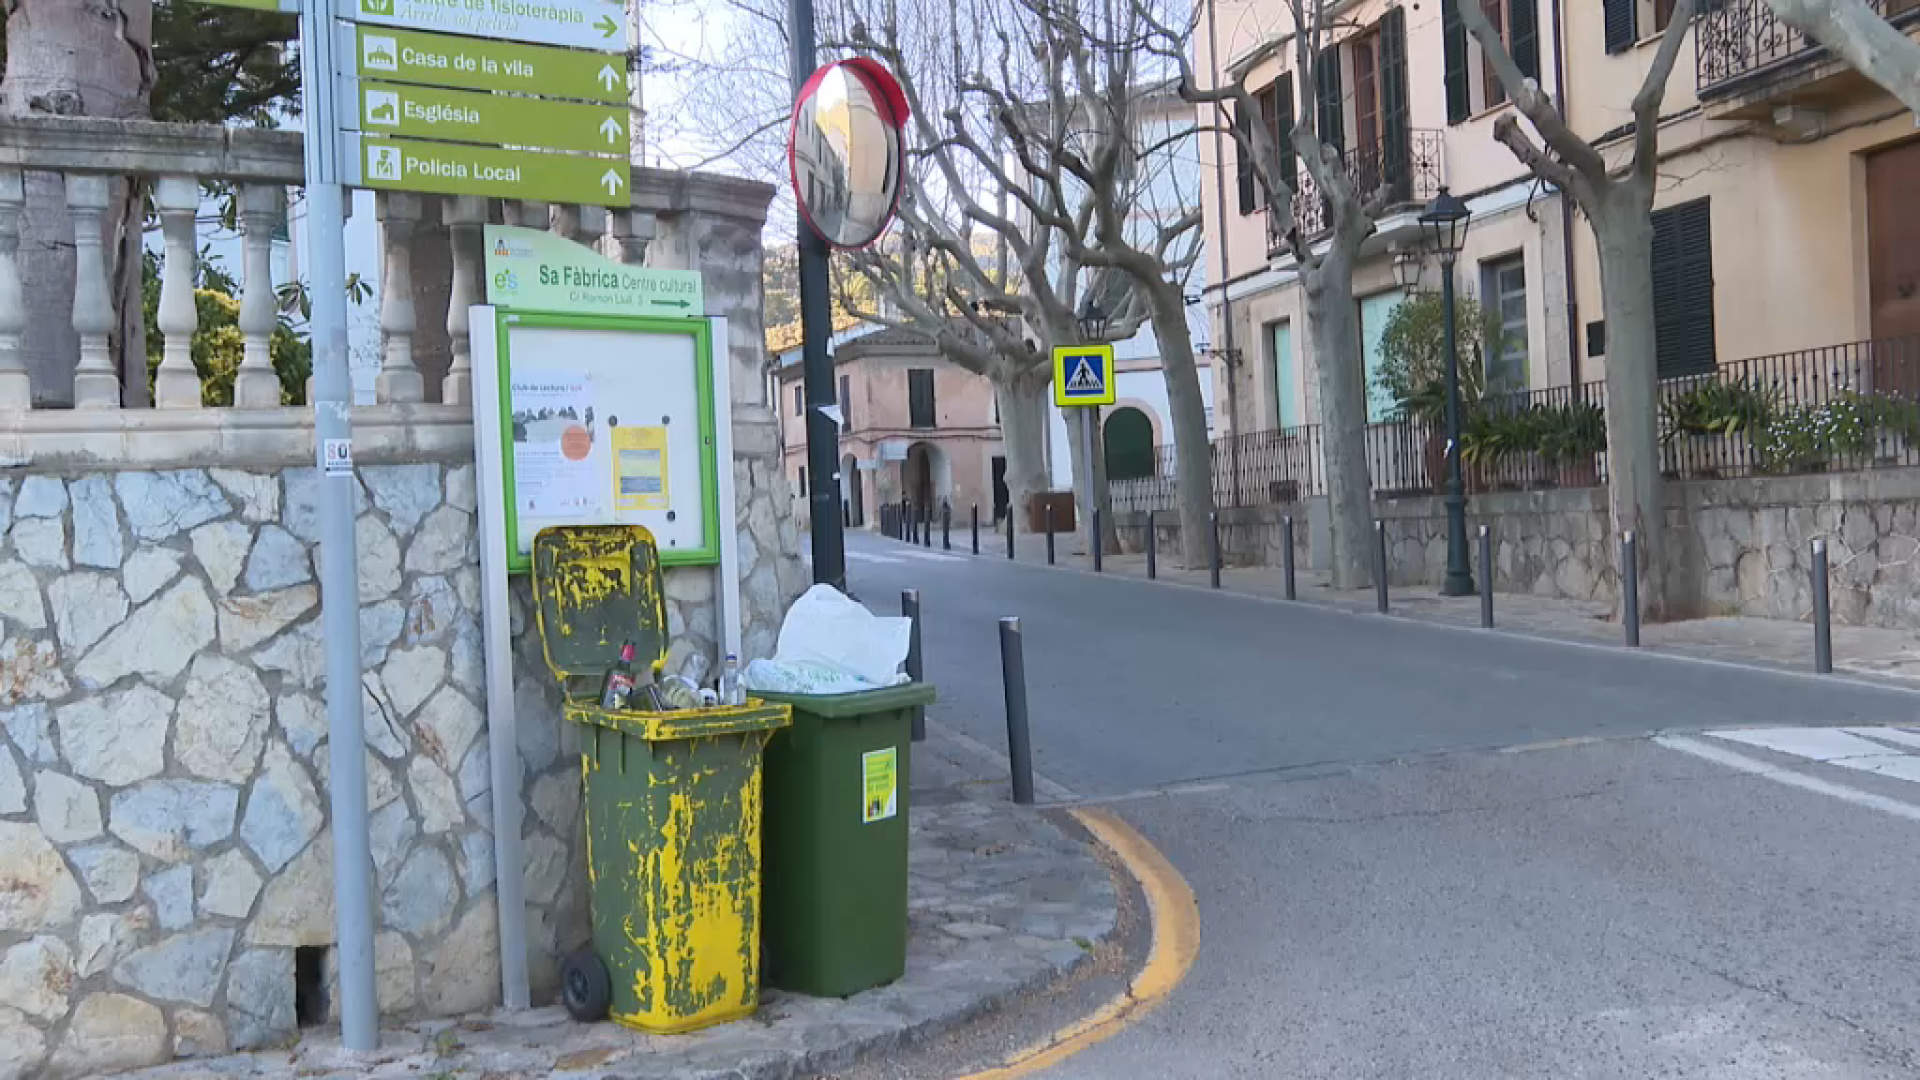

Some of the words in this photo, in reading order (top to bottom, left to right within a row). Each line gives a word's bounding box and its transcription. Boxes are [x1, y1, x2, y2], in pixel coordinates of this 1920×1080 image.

[465, 0, 485, 11] de
[402, 47, 448, 69] Casa
[454, 52, 476, 72] de
[481, 55, 498, 75] la
[503, 58, 533, 78] vila
[404, 100, 481, 125] Església
[473, 161, 521, 182] Local
[540, 264, 560, 286] Sa
[564, 265, 620, 290] Fàbrica
[659, 276, 697, 294] cultural
